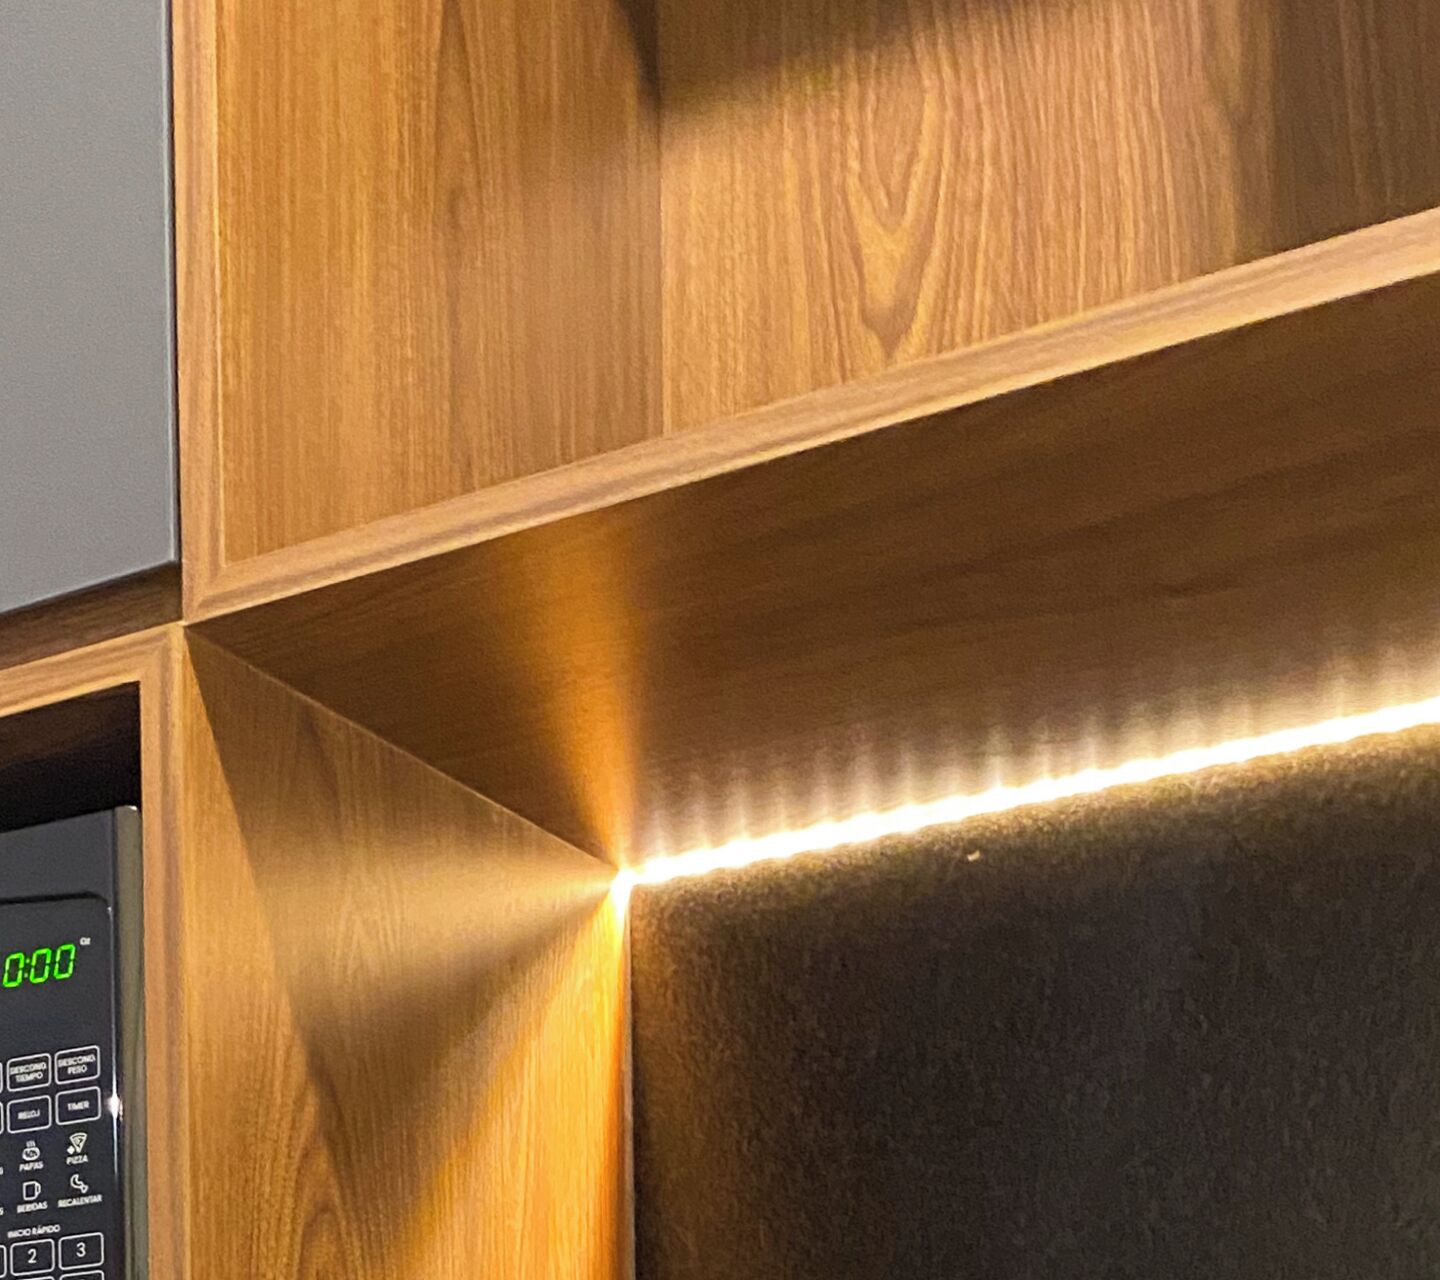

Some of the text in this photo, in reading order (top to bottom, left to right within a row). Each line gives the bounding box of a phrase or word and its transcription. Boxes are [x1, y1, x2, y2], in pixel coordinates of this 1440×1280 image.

[2, 944, 76, 988] 0:00
[67, 1064, 88, 1075] PESO
[15, 1071, 44, 1083] TIEMPO
[67, 1100, 90, 1112] TIMER
[66, 1154, 89, 1165] PIZZA
[19, 1161, 44, 1172] PAPAS
[57, 1194, 102, 1208] RECALENTAR
[17, 1201, 48, 1214] BEBIDAS
[7, 1227, 31, 1239] INICIO
[76, 1241, 87, 1257] 3
[26, 1248, 38, 1265] 2
